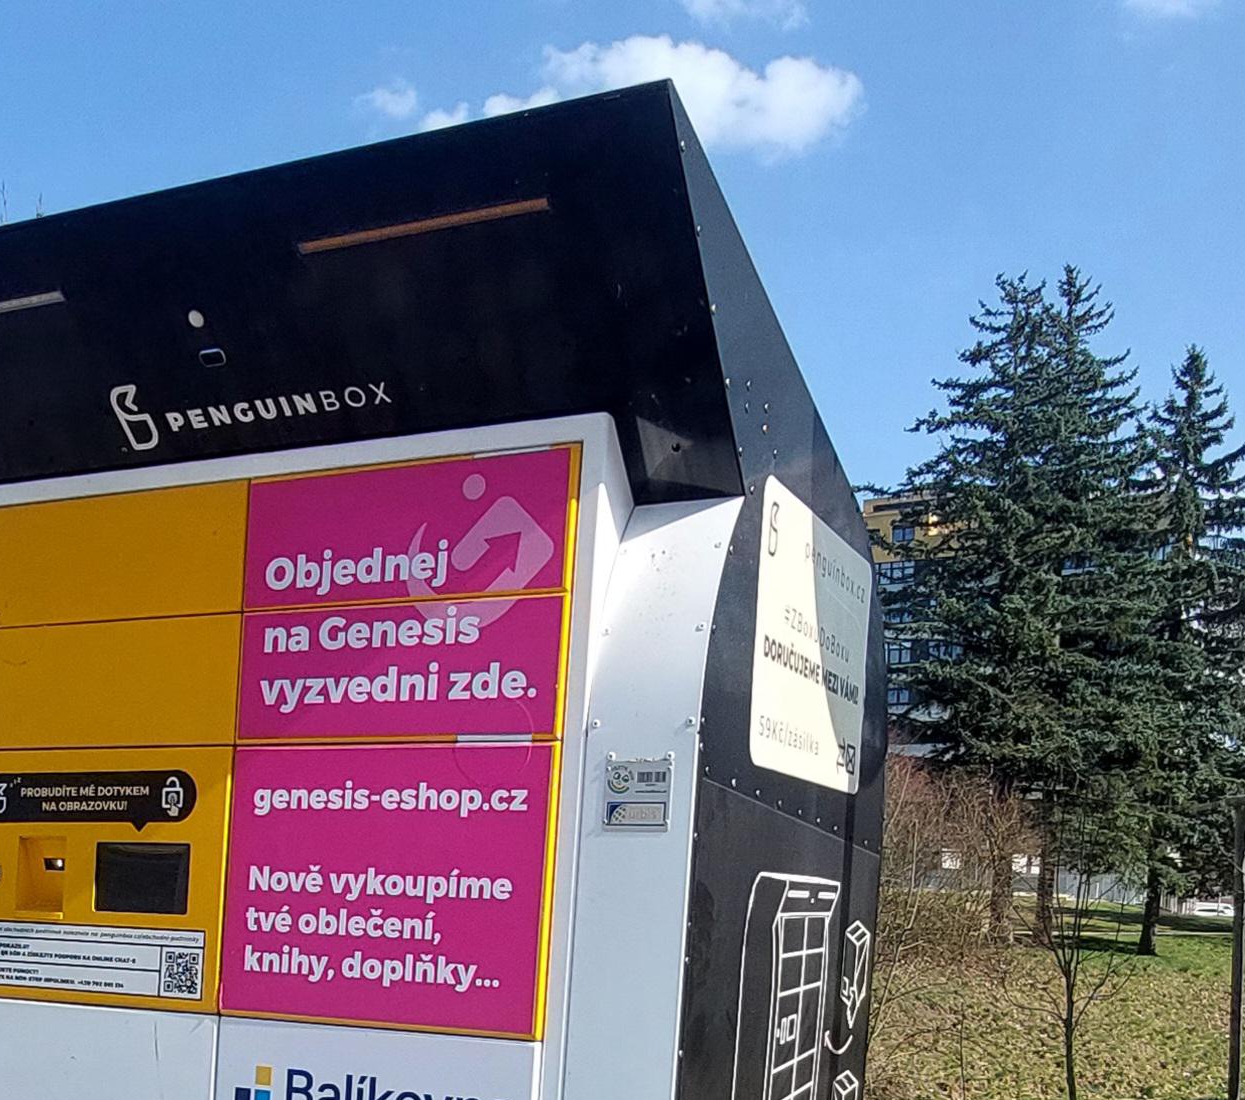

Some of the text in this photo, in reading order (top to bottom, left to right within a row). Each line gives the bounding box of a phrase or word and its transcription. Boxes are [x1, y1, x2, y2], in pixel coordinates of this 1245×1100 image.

[165, 382, 392, 432] PENGUINBOX
[265, 539, 449, 596] Objednej
[263, 606, 480, 653] na Genesis
[260, 662, 537, 714] vyzvedni zde.
[764, 635, 821, 687] DORUČUJEME
[822, 666, 839, 696] MEZI
[42, 800, 128, 811] NA OBRAZOVKU!
[97, 786, 150, 797] DOTYKEM
[253, 780, 529, 818] genesis-eshop.cz
[248, 865, 513, 904] Nově vykoupíme
[245, 905, 442, 945] tvé oblečení,
[243, 945, 500, 992] knihy, doplňky...
